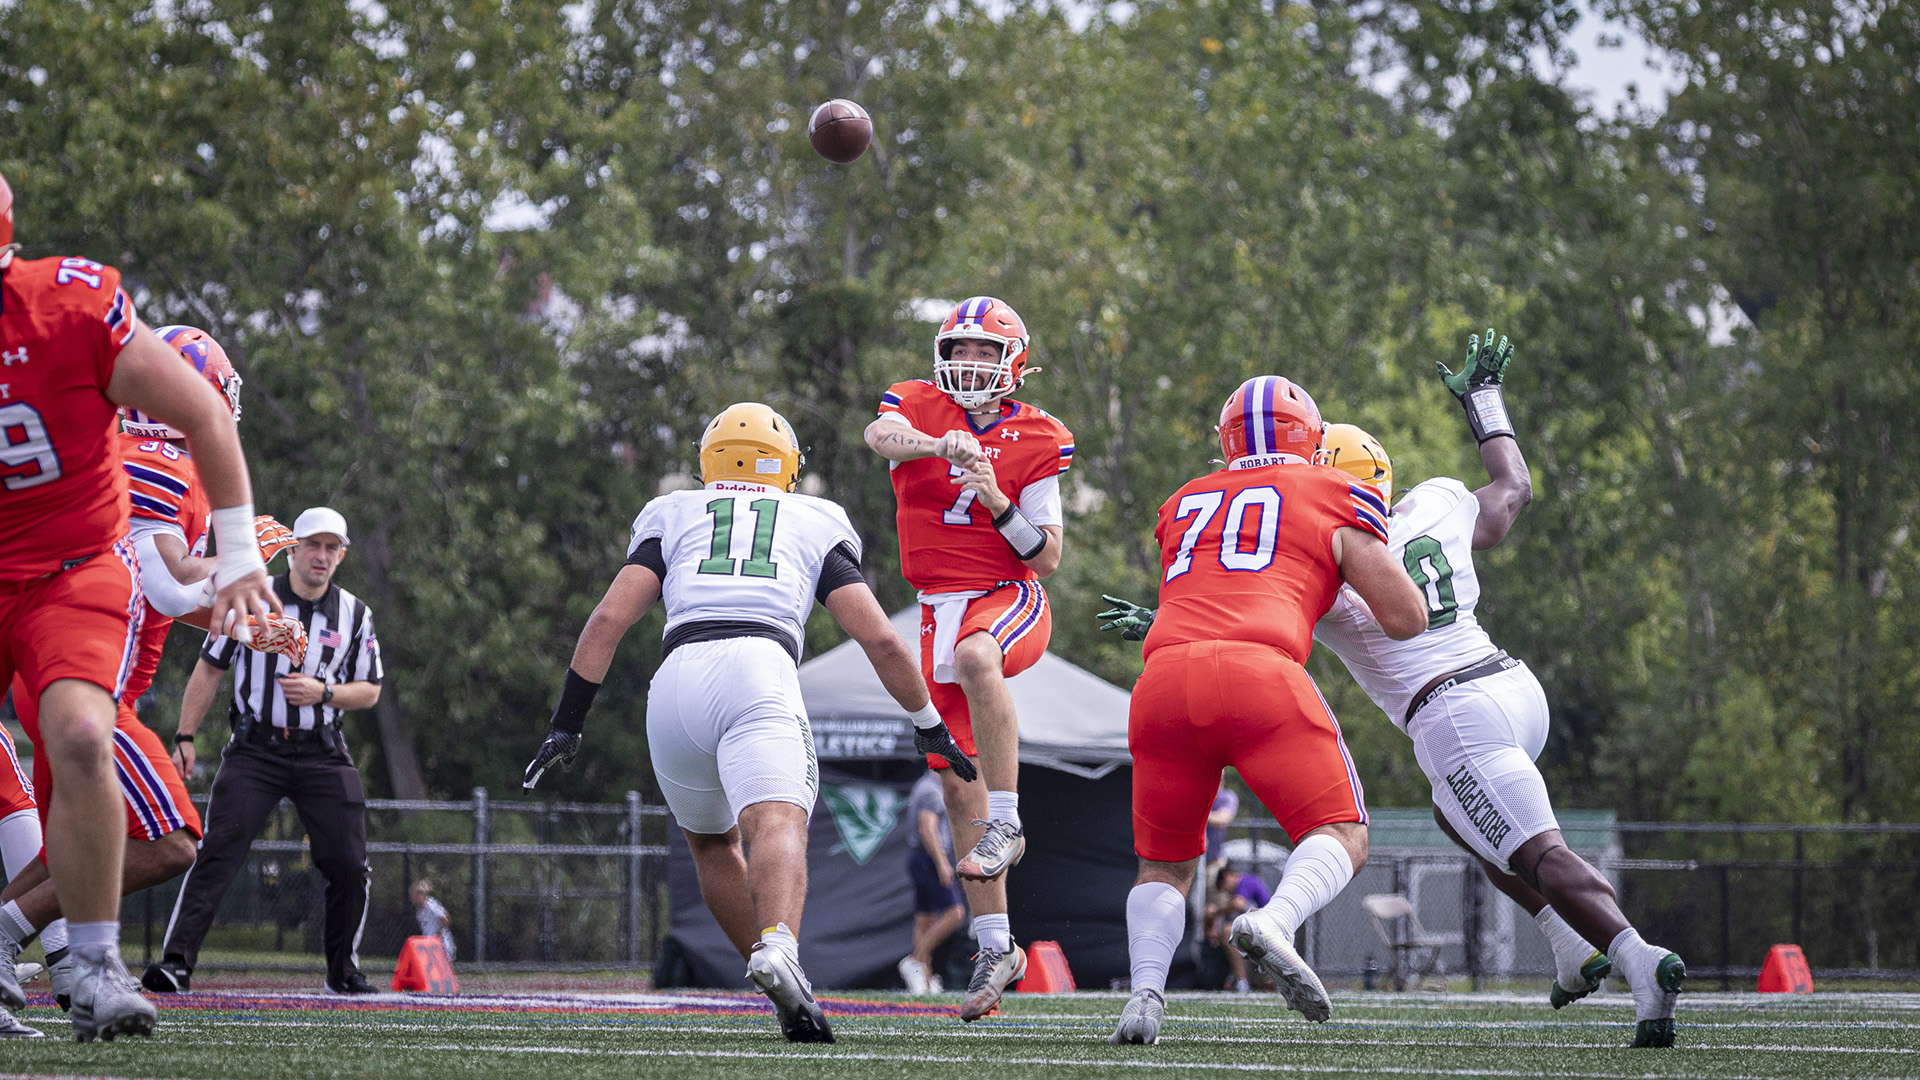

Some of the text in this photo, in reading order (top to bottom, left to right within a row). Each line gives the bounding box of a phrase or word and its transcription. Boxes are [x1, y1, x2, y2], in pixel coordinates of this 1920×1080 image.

[125, 425, 168, 438] HOBART
[1239, 456, 1286, 470] HOBART
[942, 459, 981, 526] 7
[696, 497, 780, 580] 11
[1164, 484, 1284, 587] 70
[813, 734, 898, 757] LETICS
[1446, 764, 1512, 851] BROCKPORT
